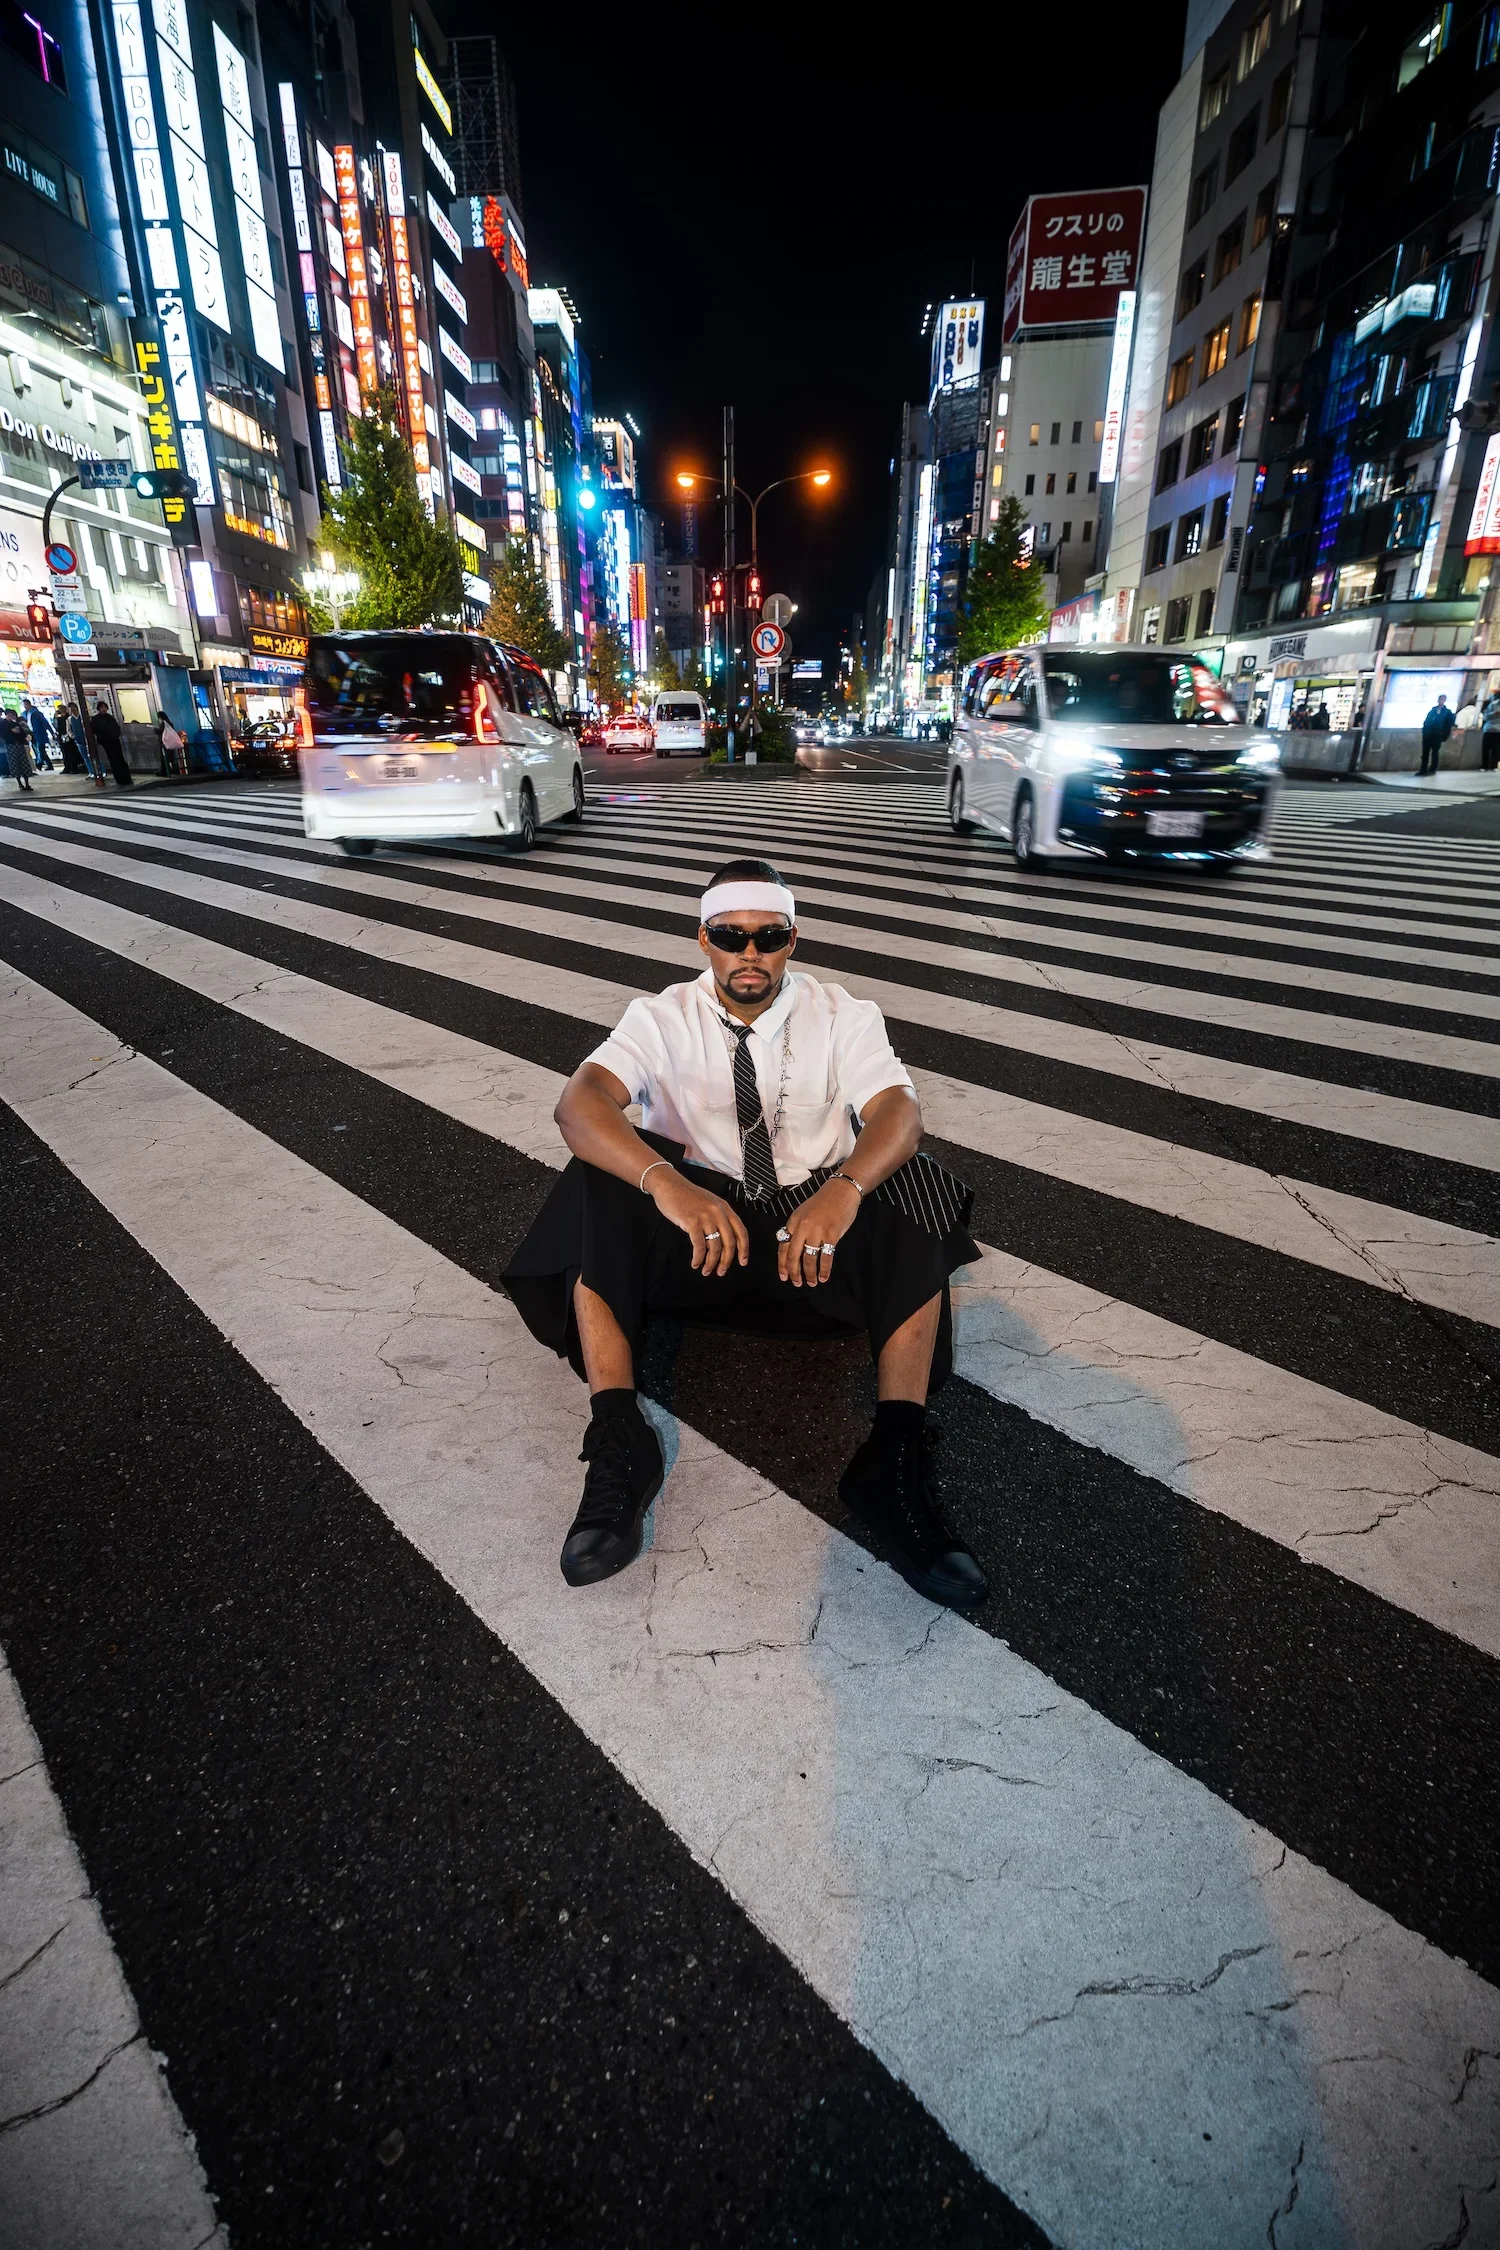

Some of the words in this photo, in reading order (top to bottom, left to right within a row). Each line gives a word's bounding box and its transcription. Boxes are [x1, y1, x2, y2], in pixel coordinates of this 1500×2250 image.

[4, 147, 29, 181] LIVE
[31, 168, 58, 202] HOUSE
[388, 157, 398, 196] 300
[1045, 212, 1125, 239] クスリの
[1029, 249, 1133, 292] 龍生堂
[393, 217, 413, 323] KARAOKE
[407, 350, 422, 421] PARTY
[0, 405, 38, 441] Don
[41, 423, 103, 462] Quijote
[136, 342, 185, 523] ドン・キホテ
[0, 531, 19, 552] NS
[65, 619, 78, 639] P
